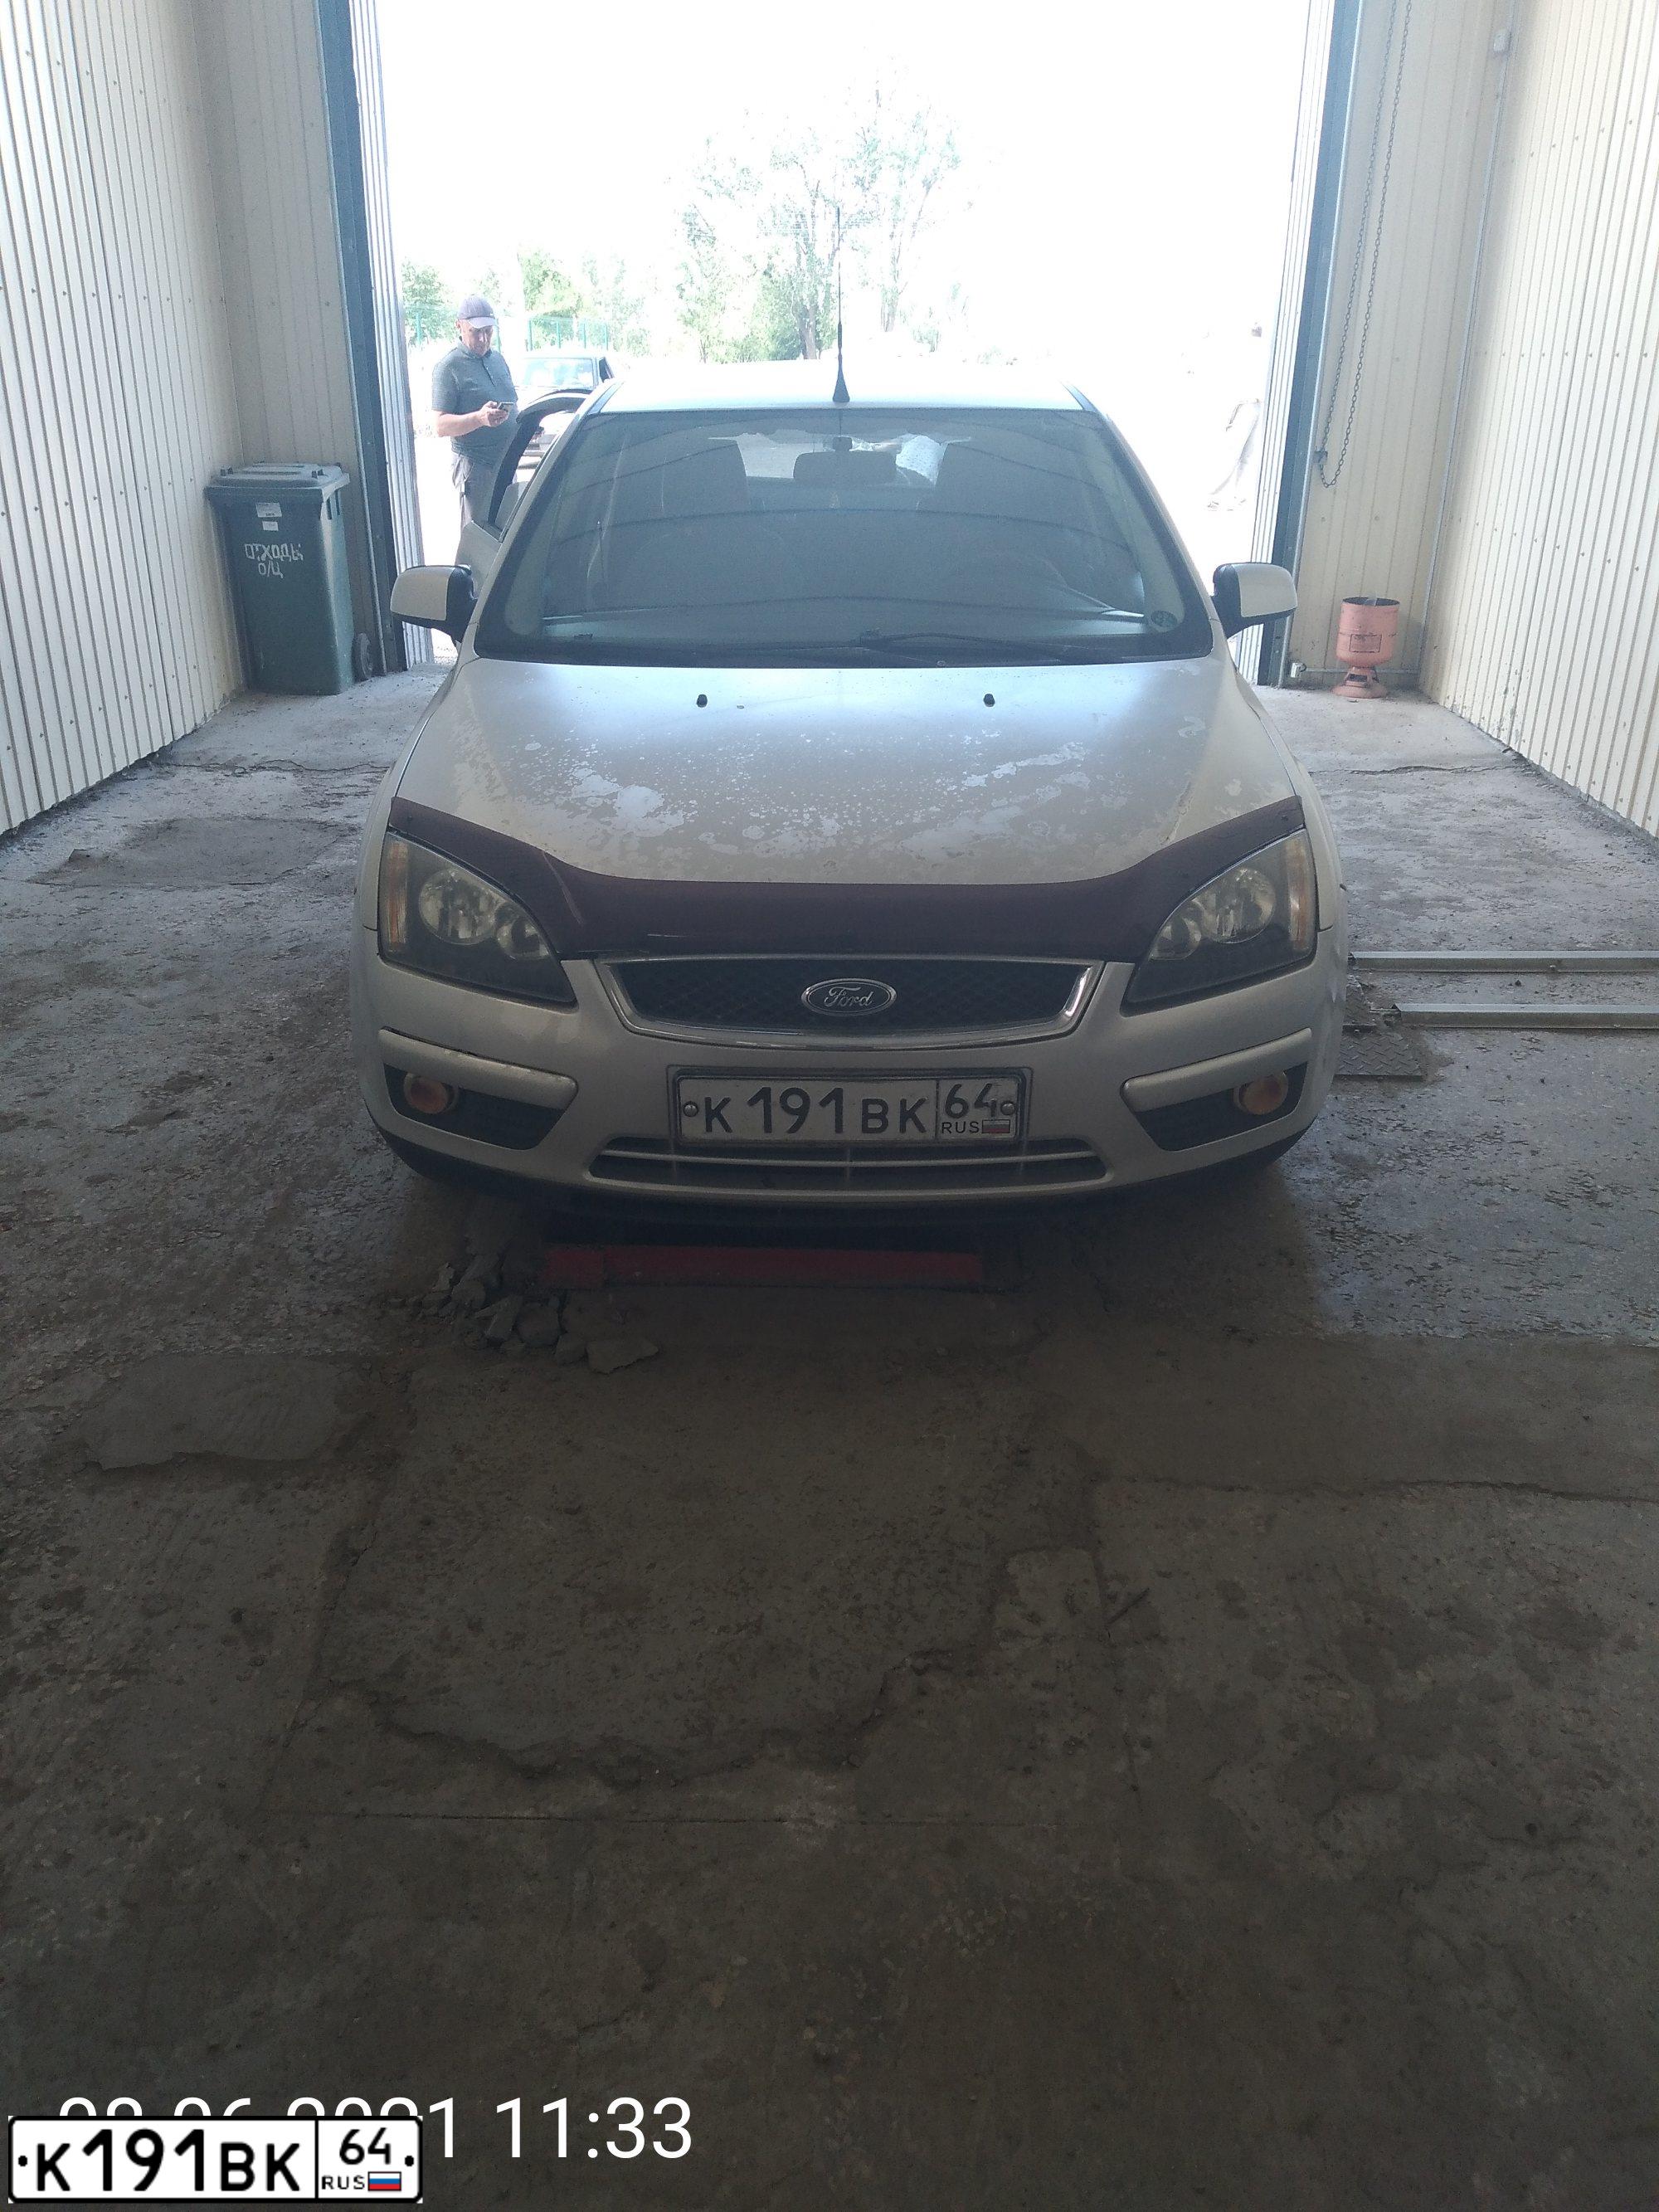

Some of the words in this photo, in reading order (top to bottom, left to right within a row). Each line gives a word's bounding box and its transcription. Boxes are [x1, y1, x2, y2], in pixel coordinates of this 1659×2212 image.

[824, 987, 873, 1007] Ford
[944, 1083, 998, 1119] 64
[941, 1121, 980, 1134] RUS
